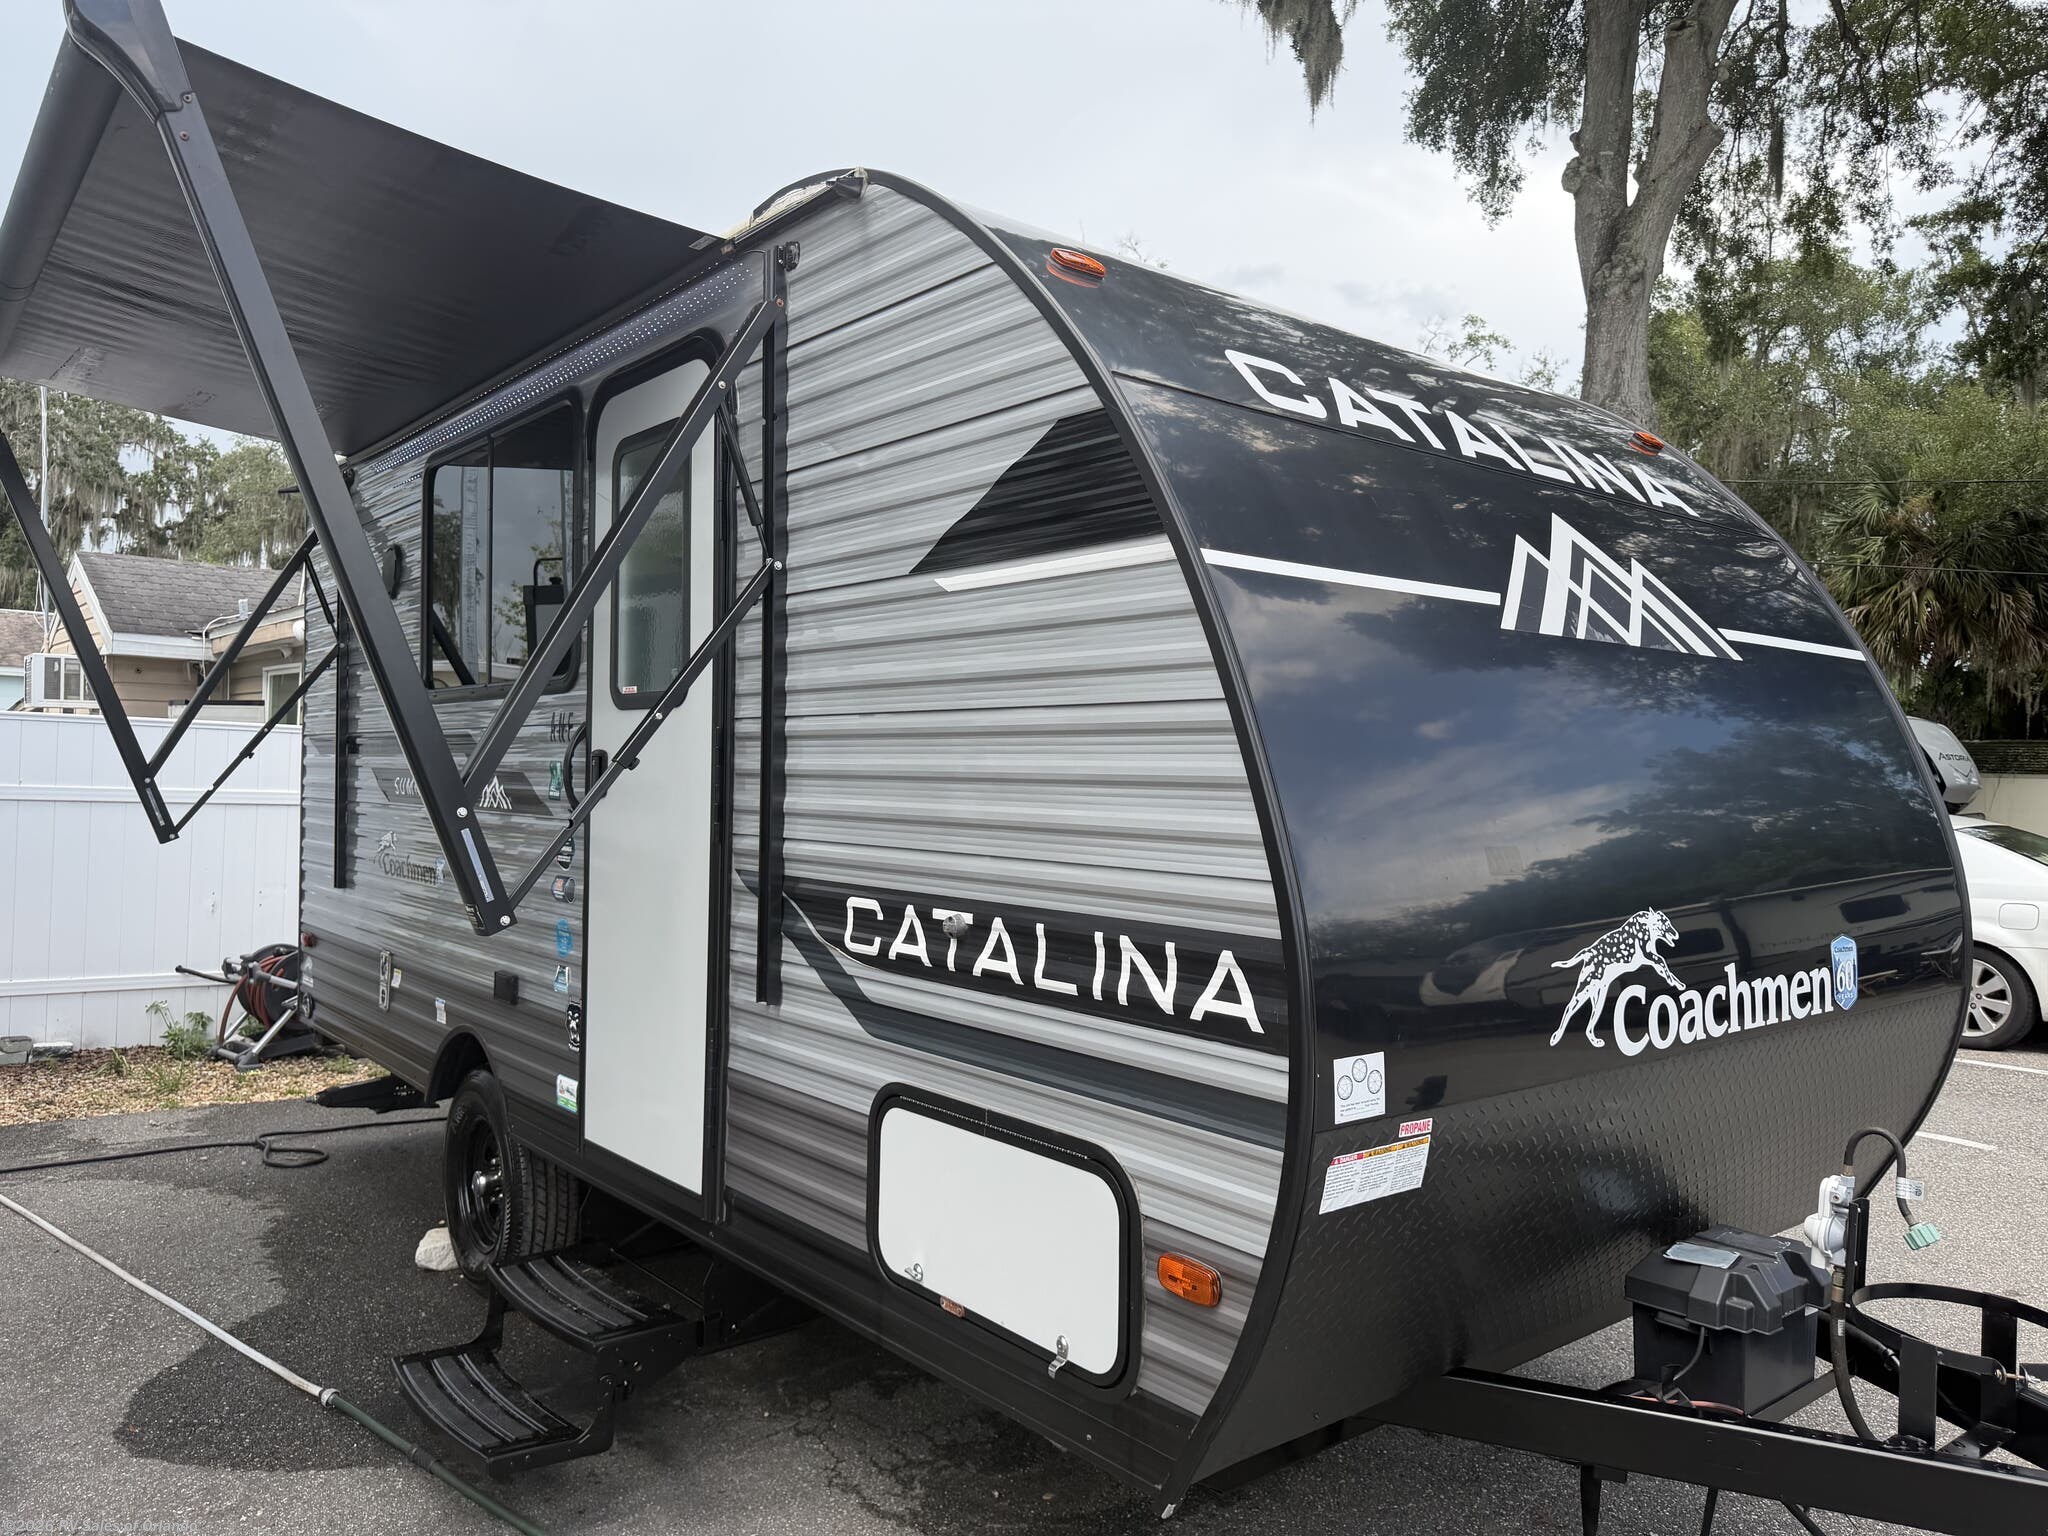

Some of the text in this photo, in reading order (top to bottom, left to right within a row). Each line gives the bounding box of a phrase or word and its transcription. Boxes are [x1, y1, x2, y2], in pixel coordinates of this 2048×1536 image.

[1224, 349, 1698, 517] CATALINA
[382, 853, 436, 885] Coachmen
[844, 896, 1265, 1034] CATALINA
[1837, 960, 1854, 993] 60
[1614, 963, 1834, 1056] Coachmen
[1400, 1120, 1431, 1135] PROPANE
